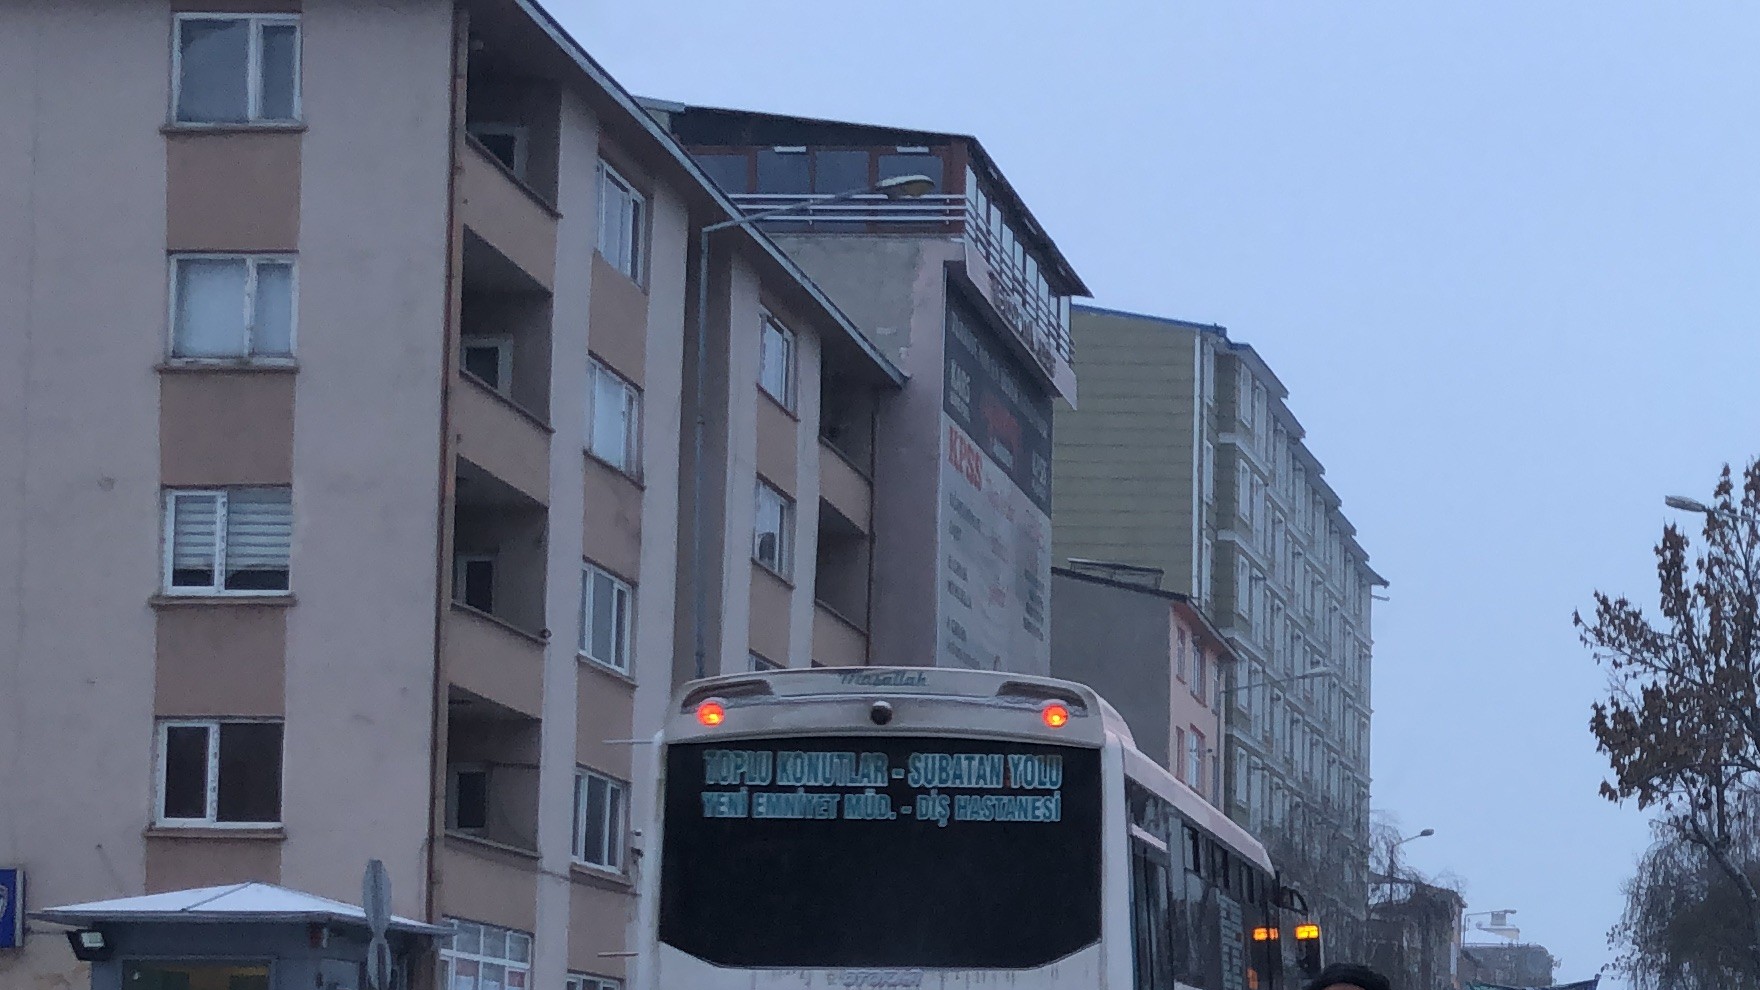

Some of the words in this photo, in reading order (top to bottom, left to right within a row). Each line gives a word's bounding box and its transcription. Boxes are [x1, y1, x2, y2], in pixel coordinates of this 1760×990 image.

[704, 751, 773, 785] TOPLU
[776, 751, 889, 786] KONUTLAR
[908, 753, 1004, 788] SUBATAN
[1008, 754, 1063, 789] YOLU
[702, 787, 748, 818] YENİ
[752, 787, 841, 819] EMNİYET
[844, 789, 897, 820] MÜD.
[916, 789, 950, 827] DİŞ
[953, 791, 1062, 822] HASTANESİ
